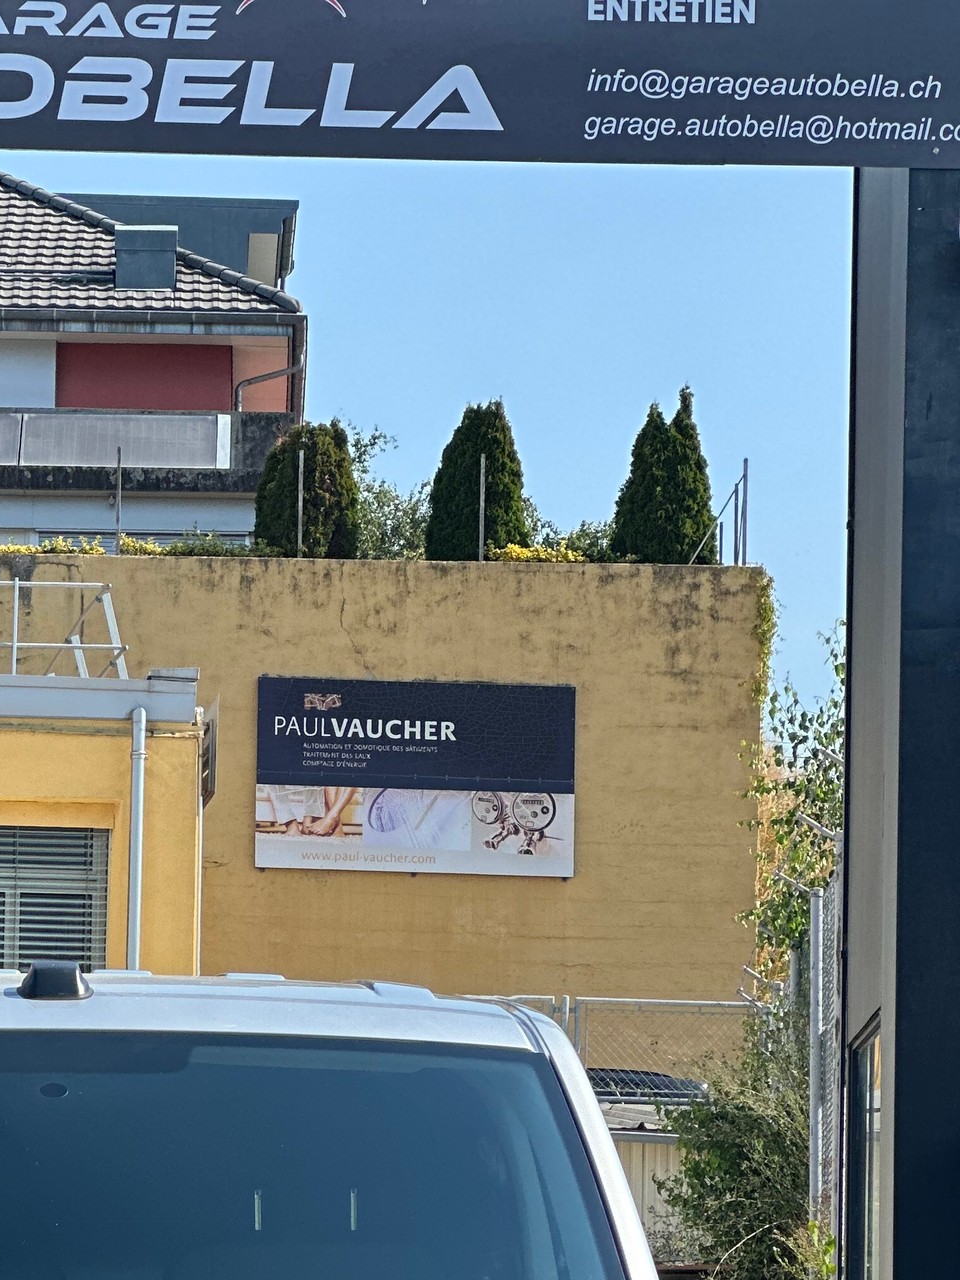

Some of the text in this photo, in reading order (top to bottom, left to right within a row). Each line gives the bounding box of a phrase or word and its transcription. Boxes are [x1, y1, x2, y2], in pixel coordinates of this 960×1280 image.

[587, 0, 756, 24] ENTRETIEN
[586, 68, 942, 101] info@garageautobella.ch
[274, 716, 457, 741] PAULVAUCHER
[301, 851, 436, 865] www.paul-vaucher.com
